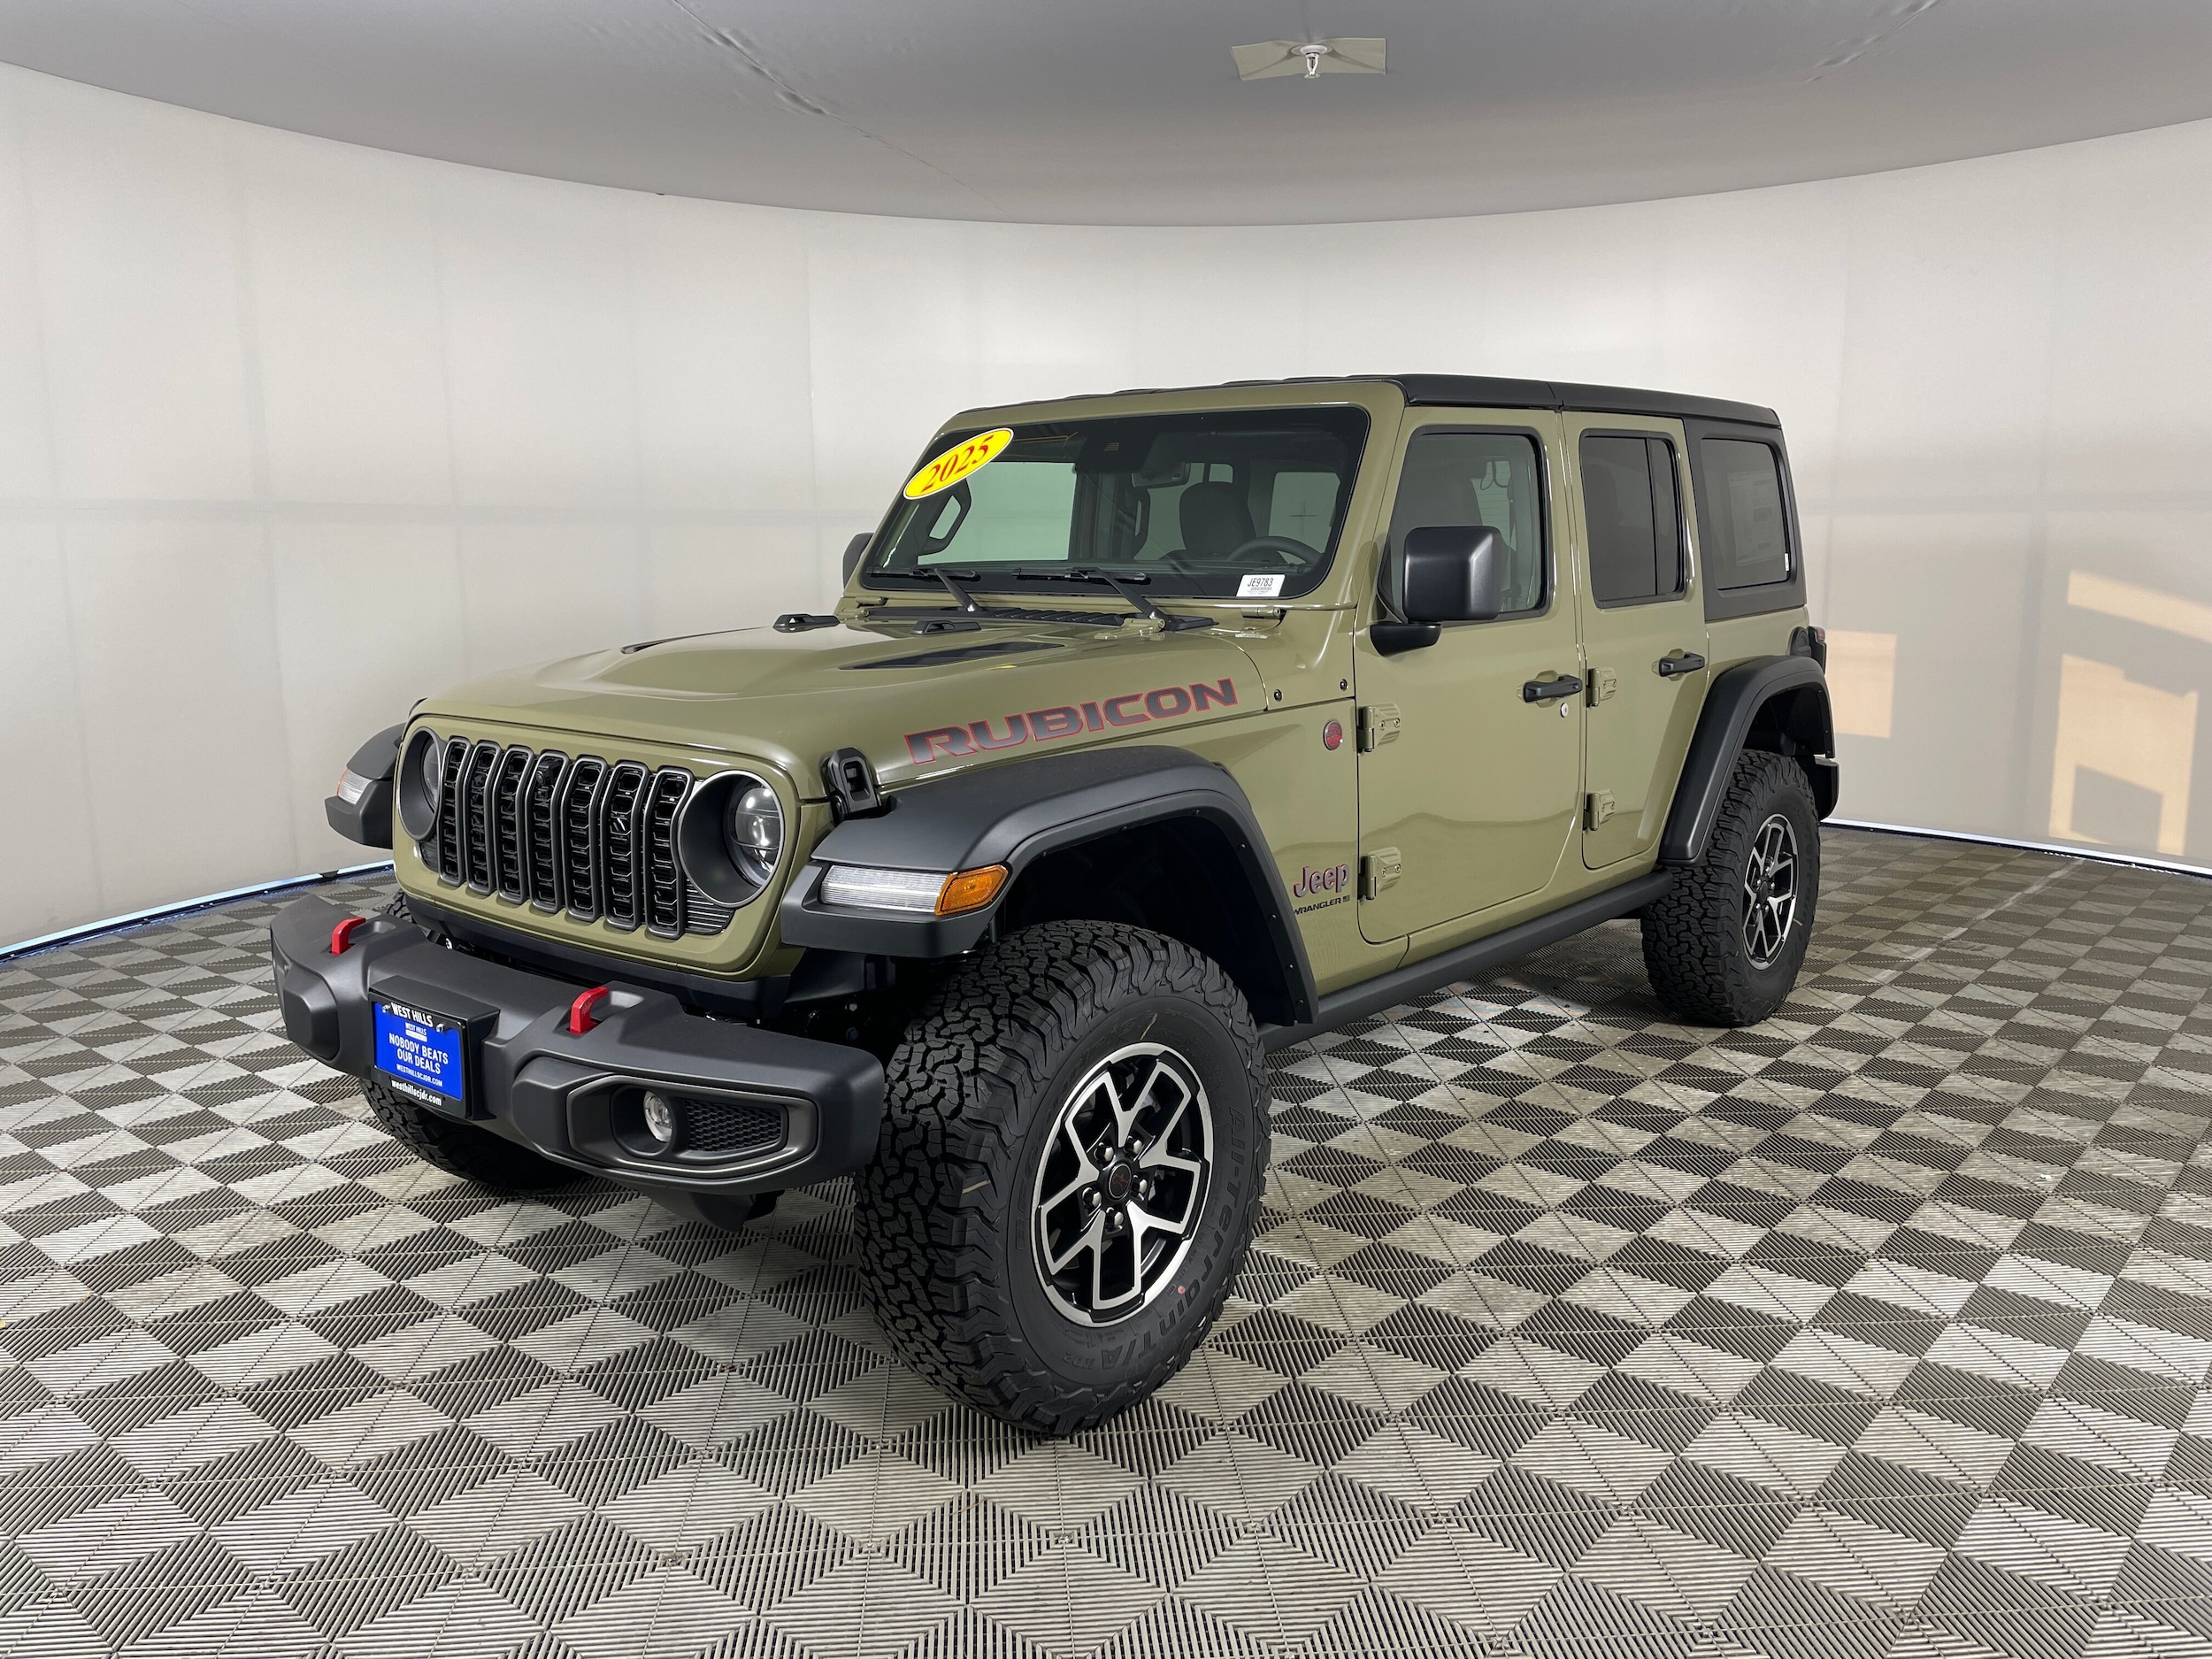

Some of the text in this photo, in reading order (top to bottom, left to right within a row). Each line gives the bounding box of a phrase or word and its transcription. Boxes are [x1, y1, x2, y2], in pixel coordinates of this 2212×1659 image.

[920, 434, 994, 493] 2025
[1248, 577, 1274, 588] JE9783
[903, 678, 1239, 765] RUBICON
[1294, 864, 1349, 897] Jeep
[391, 1002, 434, 1027] WEST HILLS
[405, 1022, 416, 1032] WEST
[415, 1025, 426, 1036] HILLS
[389, 1033, 419, 1054] NOBODY
[421, 1045, 449, 1064] BEATS
[397, 1048, 441, 1074] OUR DEALS
[396, 1064, 443, 1087] WESTHILLSCJDR.COM
[391, 1080, 442, 1106] westhillscjdr.com
